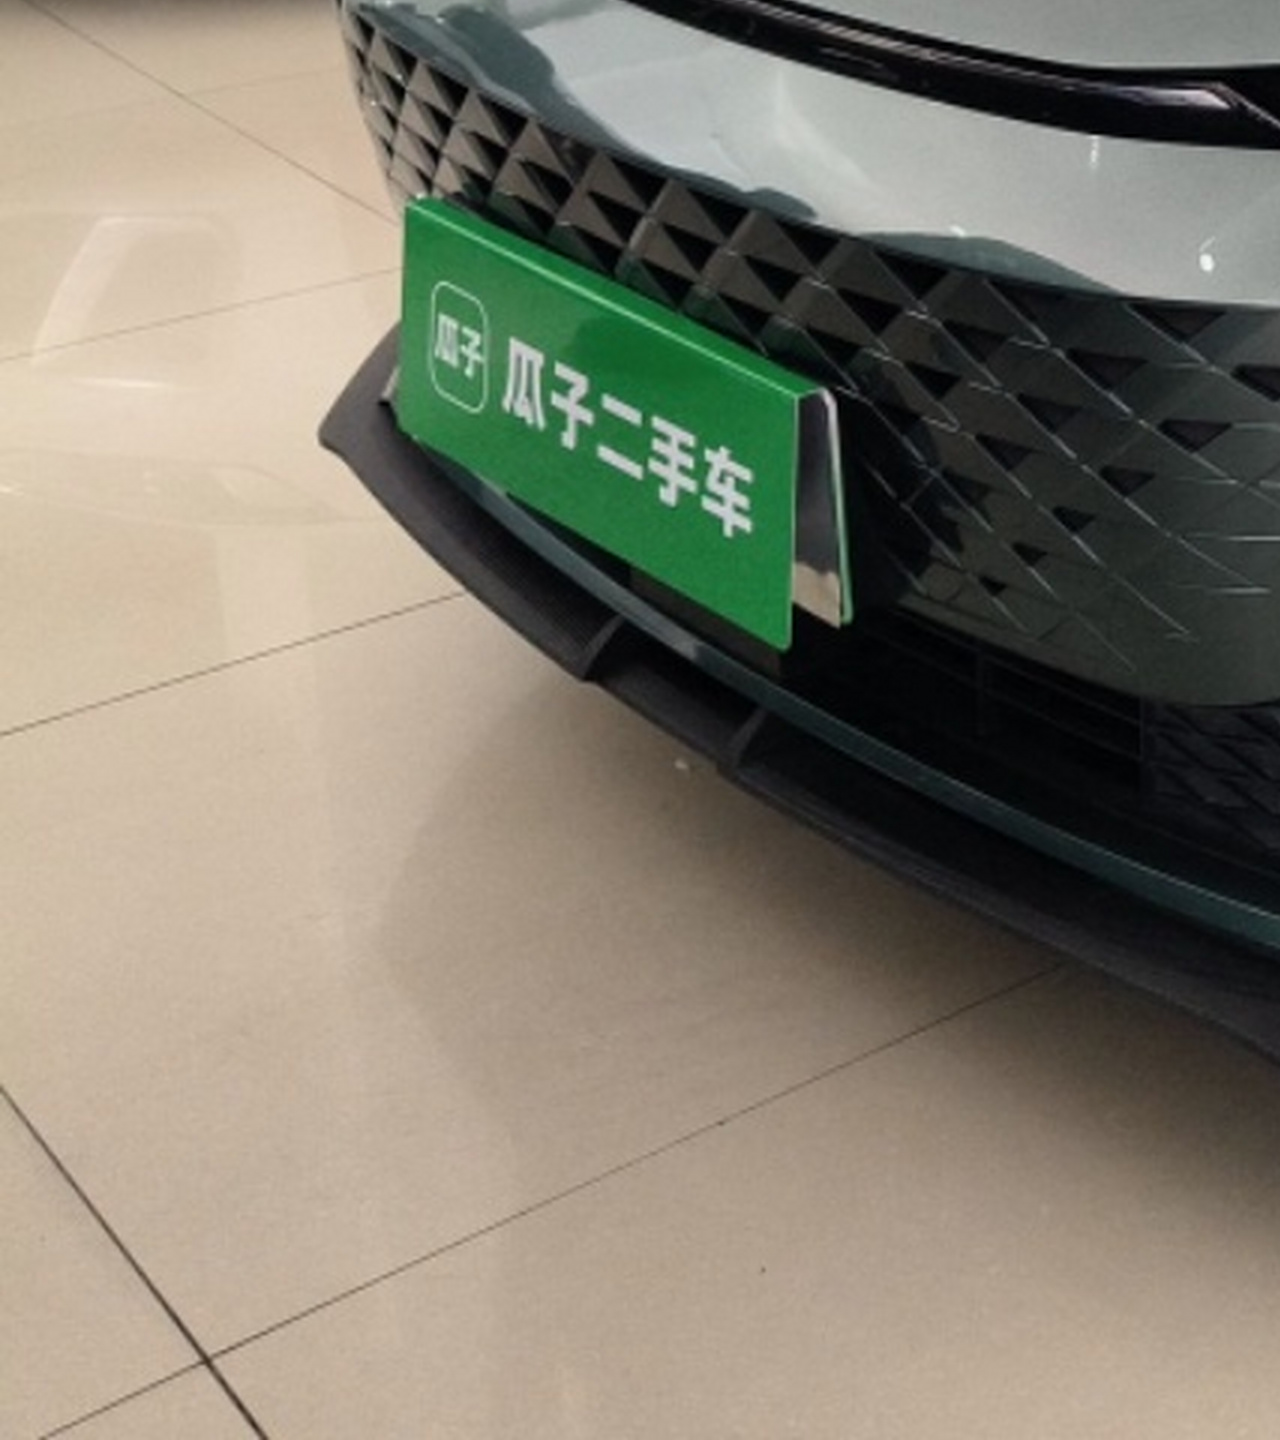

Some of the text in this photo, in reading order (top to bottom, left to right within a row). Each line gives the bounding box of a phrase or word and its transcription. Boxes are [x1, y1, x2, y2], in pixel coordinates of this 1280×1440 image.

[434, 313, 484, 378] 瓜子
[502, 337, 753, 538] 瓜子二手车
